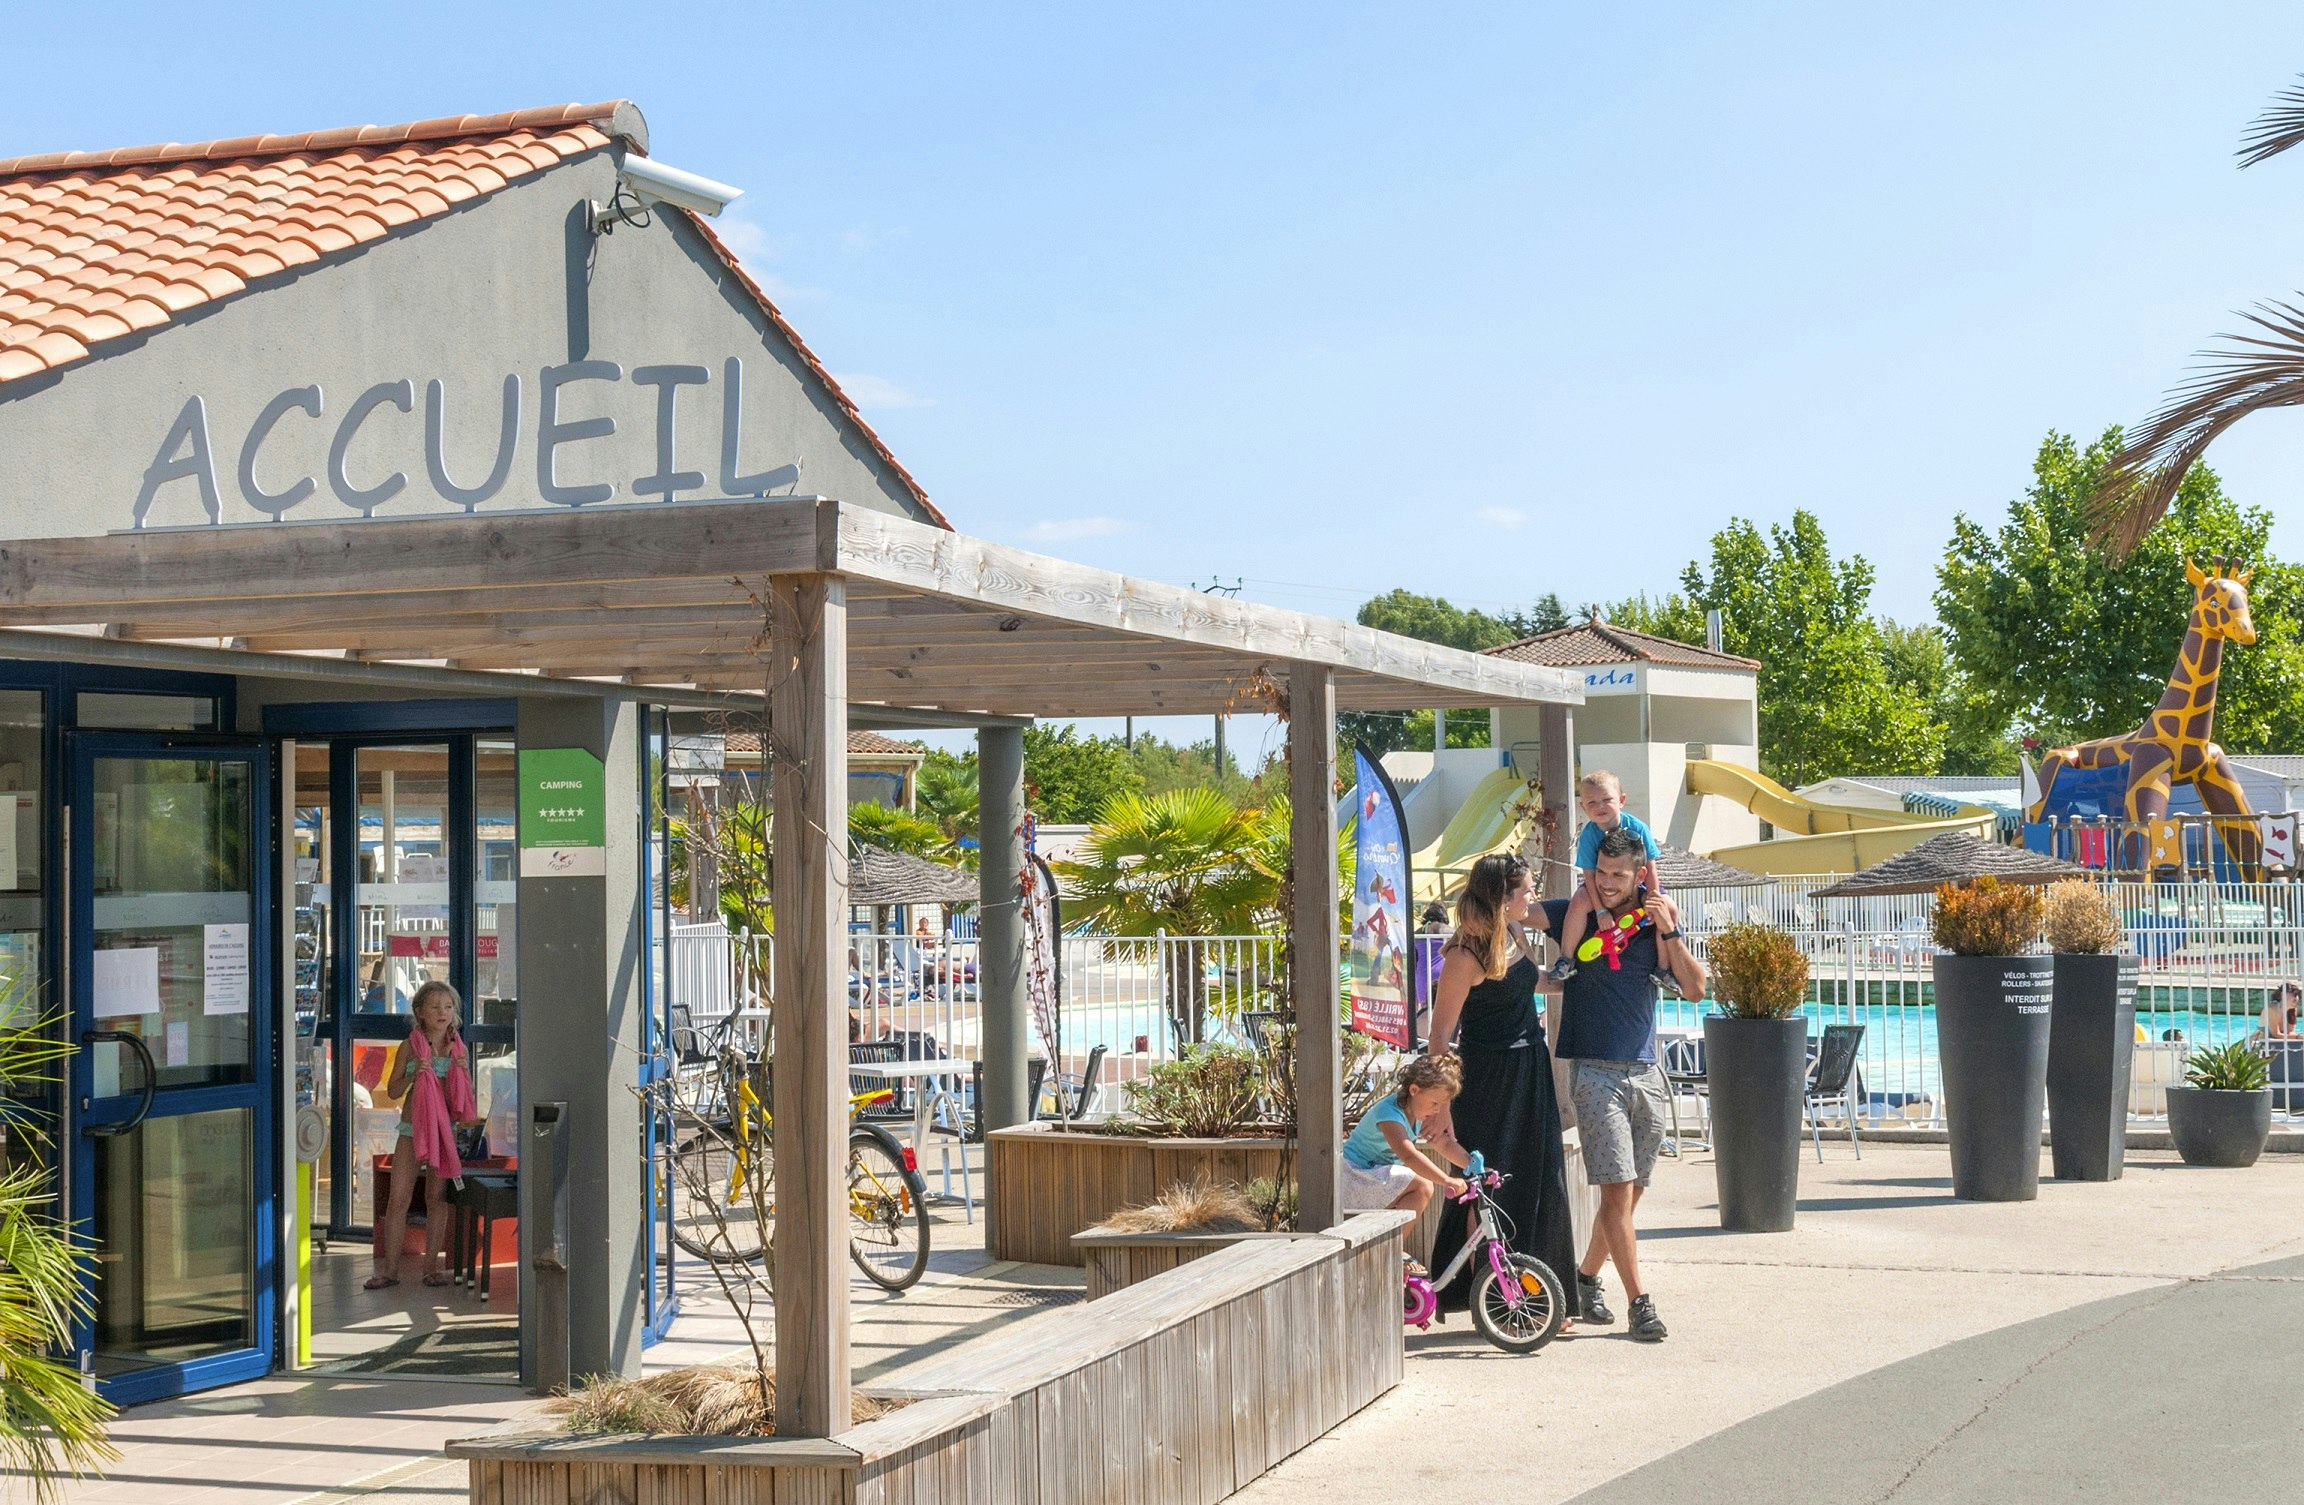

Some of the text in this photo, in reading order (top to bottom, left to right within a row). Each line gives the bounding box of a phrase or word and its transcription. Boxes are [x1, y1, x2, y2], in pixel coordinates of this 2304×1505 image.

[132, 356, 802, 522] ACCUEIL
[1585, 669, 1635, 686] ada
[540, 780, 582, 790] CAMPING
[2003, 971, 2026, 979] VÉLOS
[2005, 994, 2040, 1003] INTERDIT
[2017, 1005, 2049, 1014] TERRASSE
